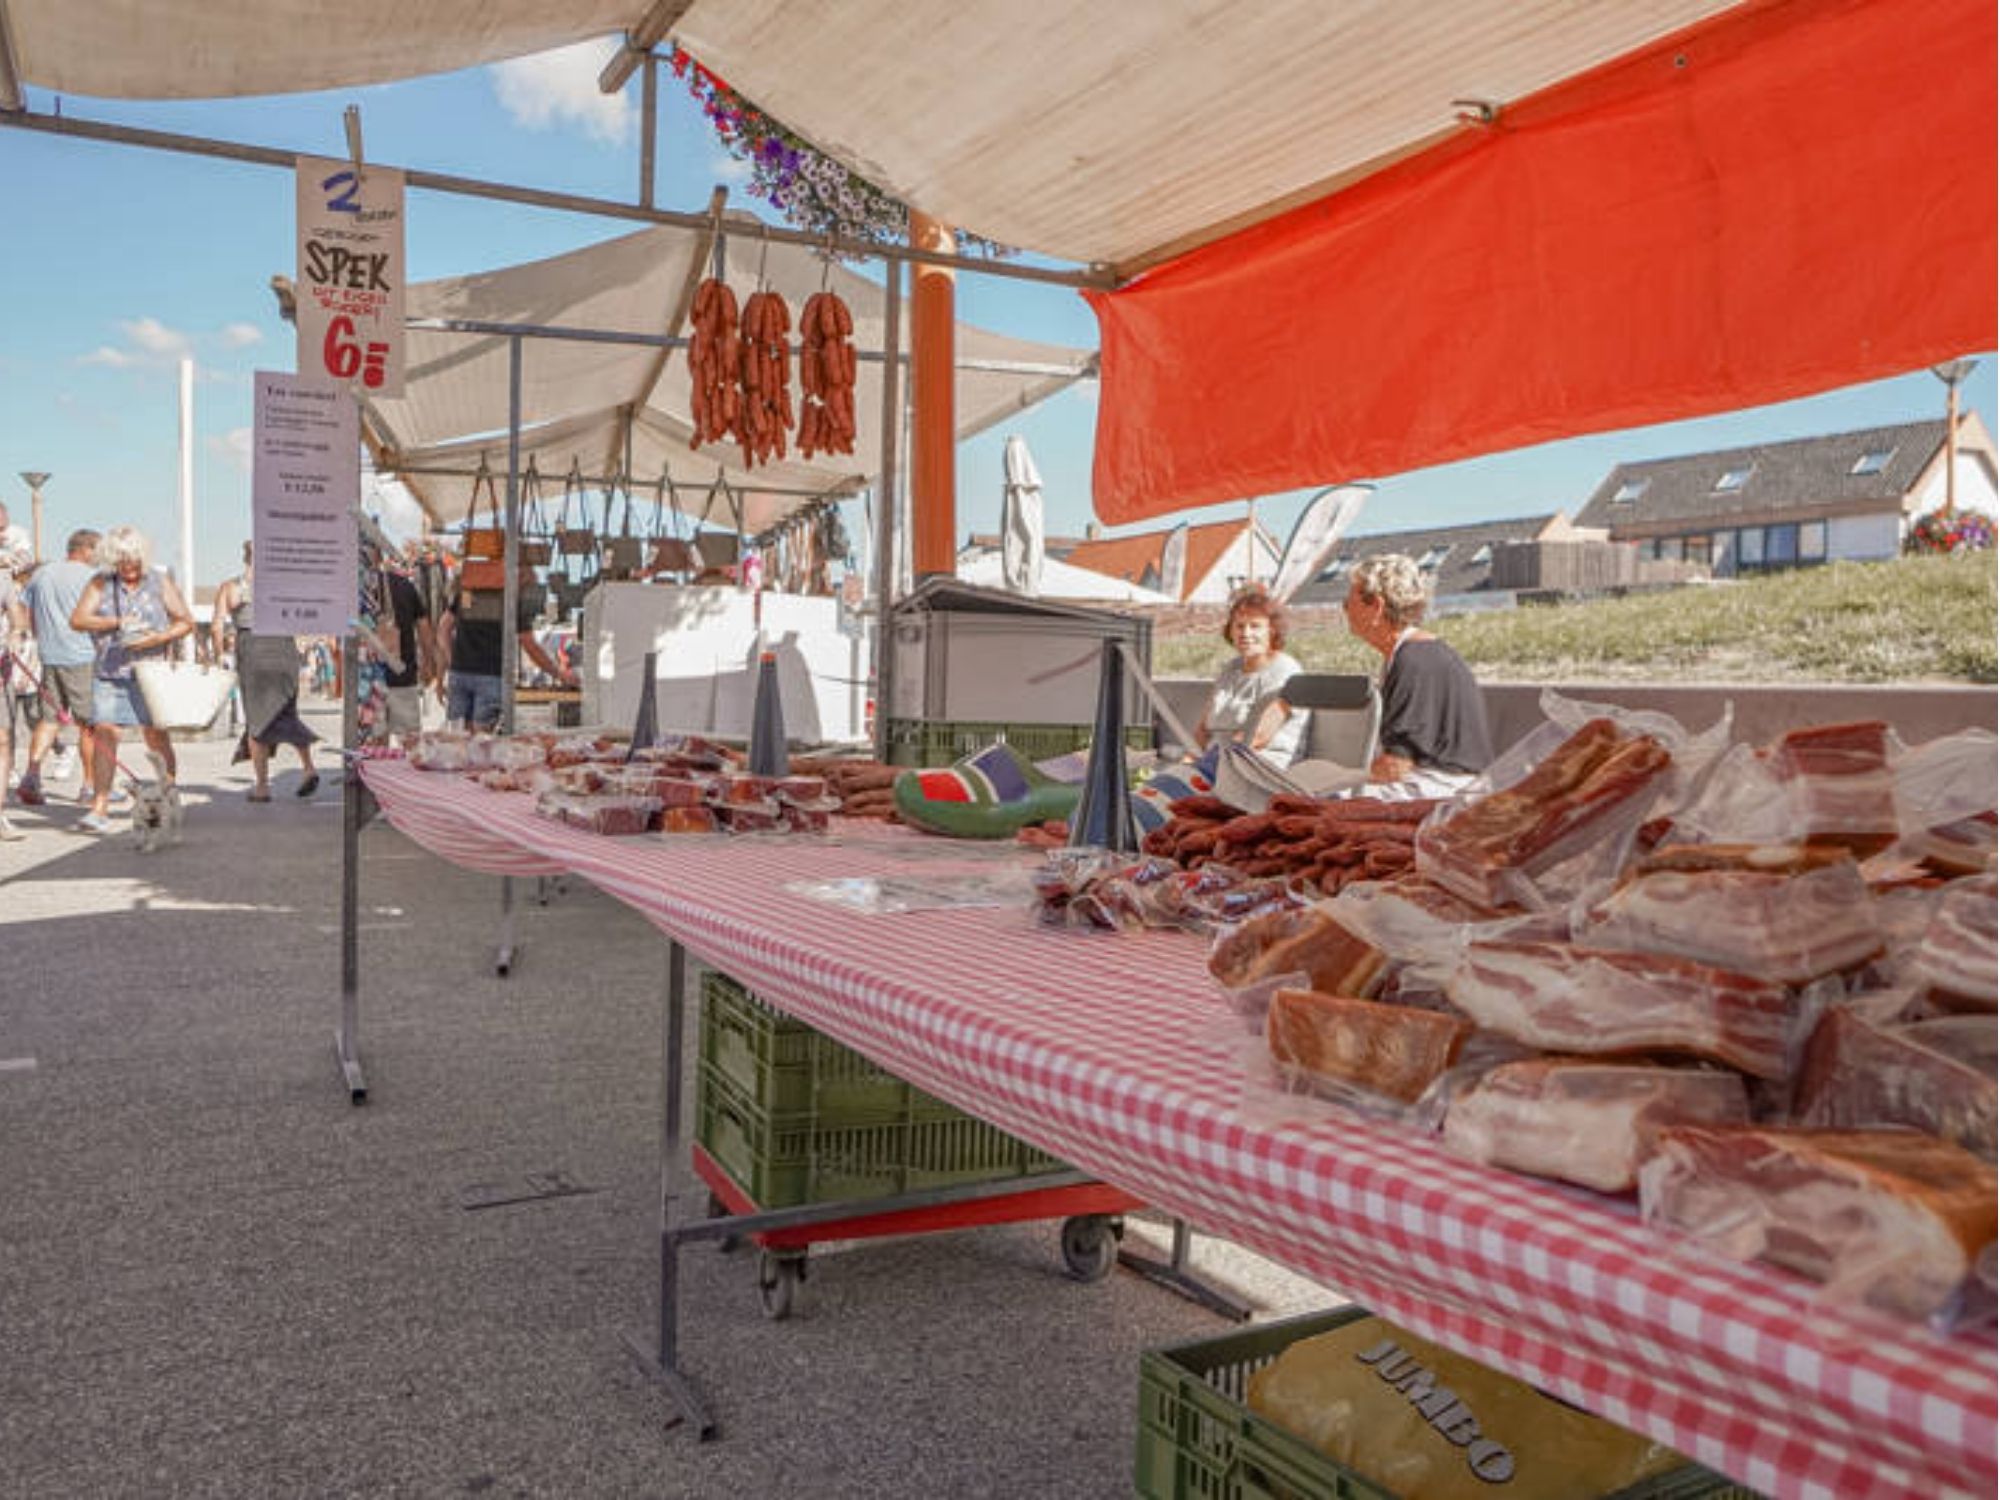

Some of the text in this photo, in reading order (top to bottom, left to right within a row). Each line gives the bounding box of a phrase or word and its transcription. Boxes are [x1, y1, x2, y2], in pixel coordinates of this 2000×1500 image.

[322, 172, 362, 213] 2
[305, 240, 391, 292] SPEK
[1356, 1339, 1515, 1483] JUMBO
